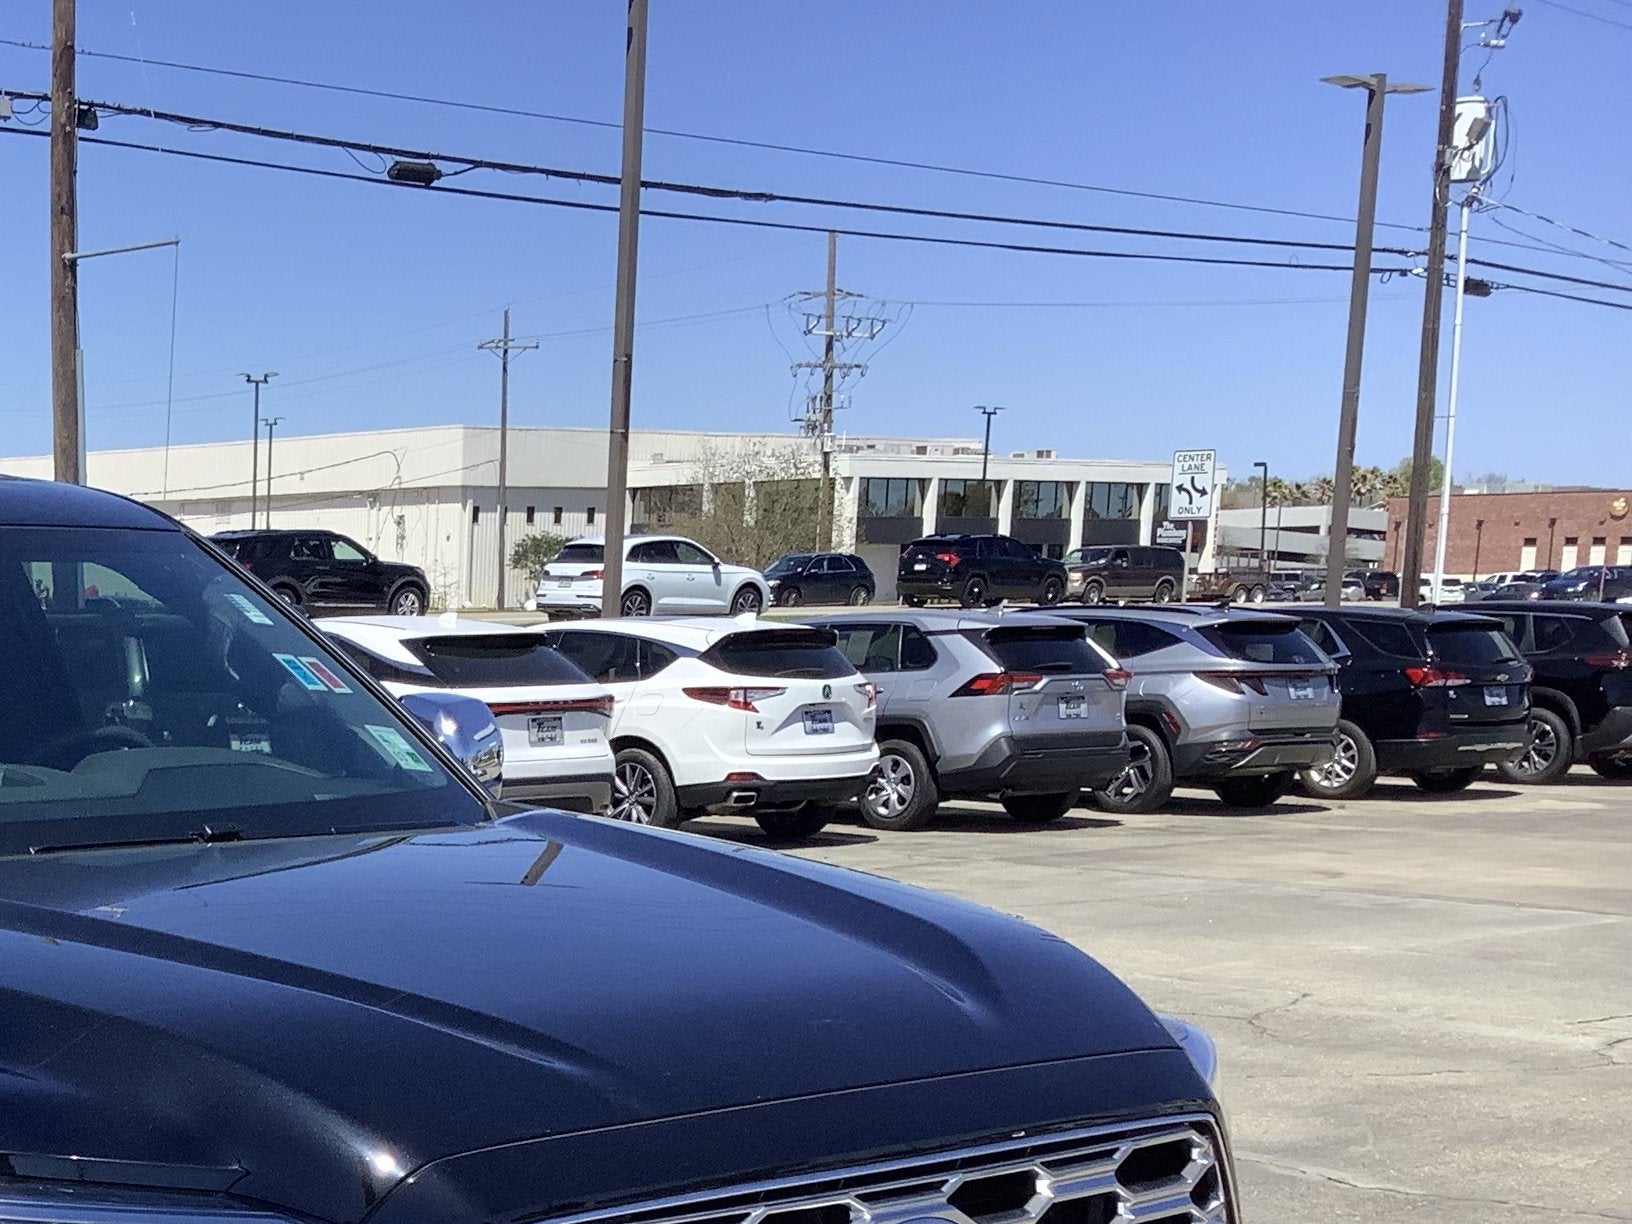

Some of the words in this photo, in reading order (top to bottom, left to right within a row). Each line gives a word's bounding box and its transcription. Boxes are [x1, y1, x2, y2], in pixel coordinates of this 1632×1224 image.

[1177, 453, 1212, 463] CENTER
[1181, 463, 1206, 472] LANE
[1177, 506, 1203, 515] ONLY
